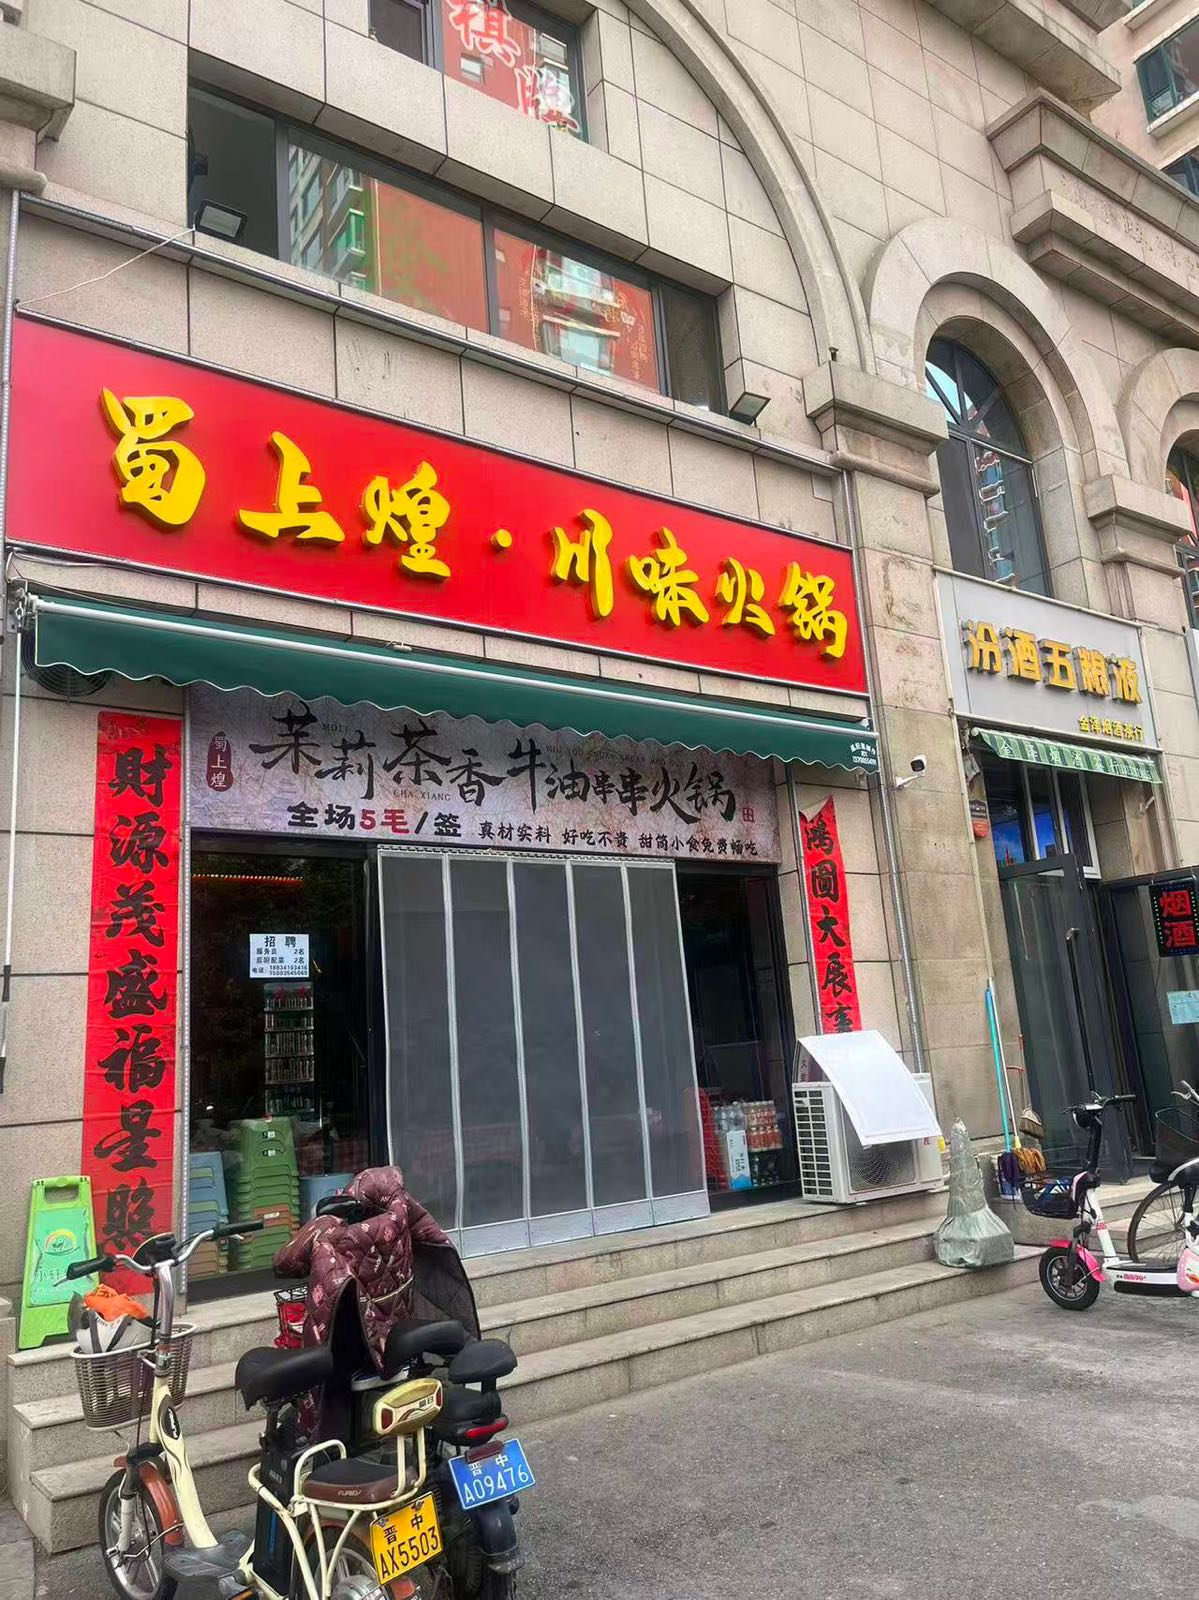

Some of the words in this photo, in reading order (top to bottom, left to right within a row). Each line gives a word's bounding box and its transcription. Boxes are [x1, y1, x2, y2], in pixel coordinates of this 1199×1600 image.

[962, 619, 1143, 705] 汾酒五粮液
[209, 735, 228, 789] 蜀上煌
[249, 698, 736, 825] 茉莉茶香牛油串串火锅
[287, 801, 462, 838] 全场5毛/签
[478, 821, 552, 845] 真材实料
[561, 828, 628, 848] 好吃不贵
[1159, 890, 1196, 947] 烟酒
[463, 1465, 529, 1504] A09476
[379, 1527, 440, 1580] AX5503
